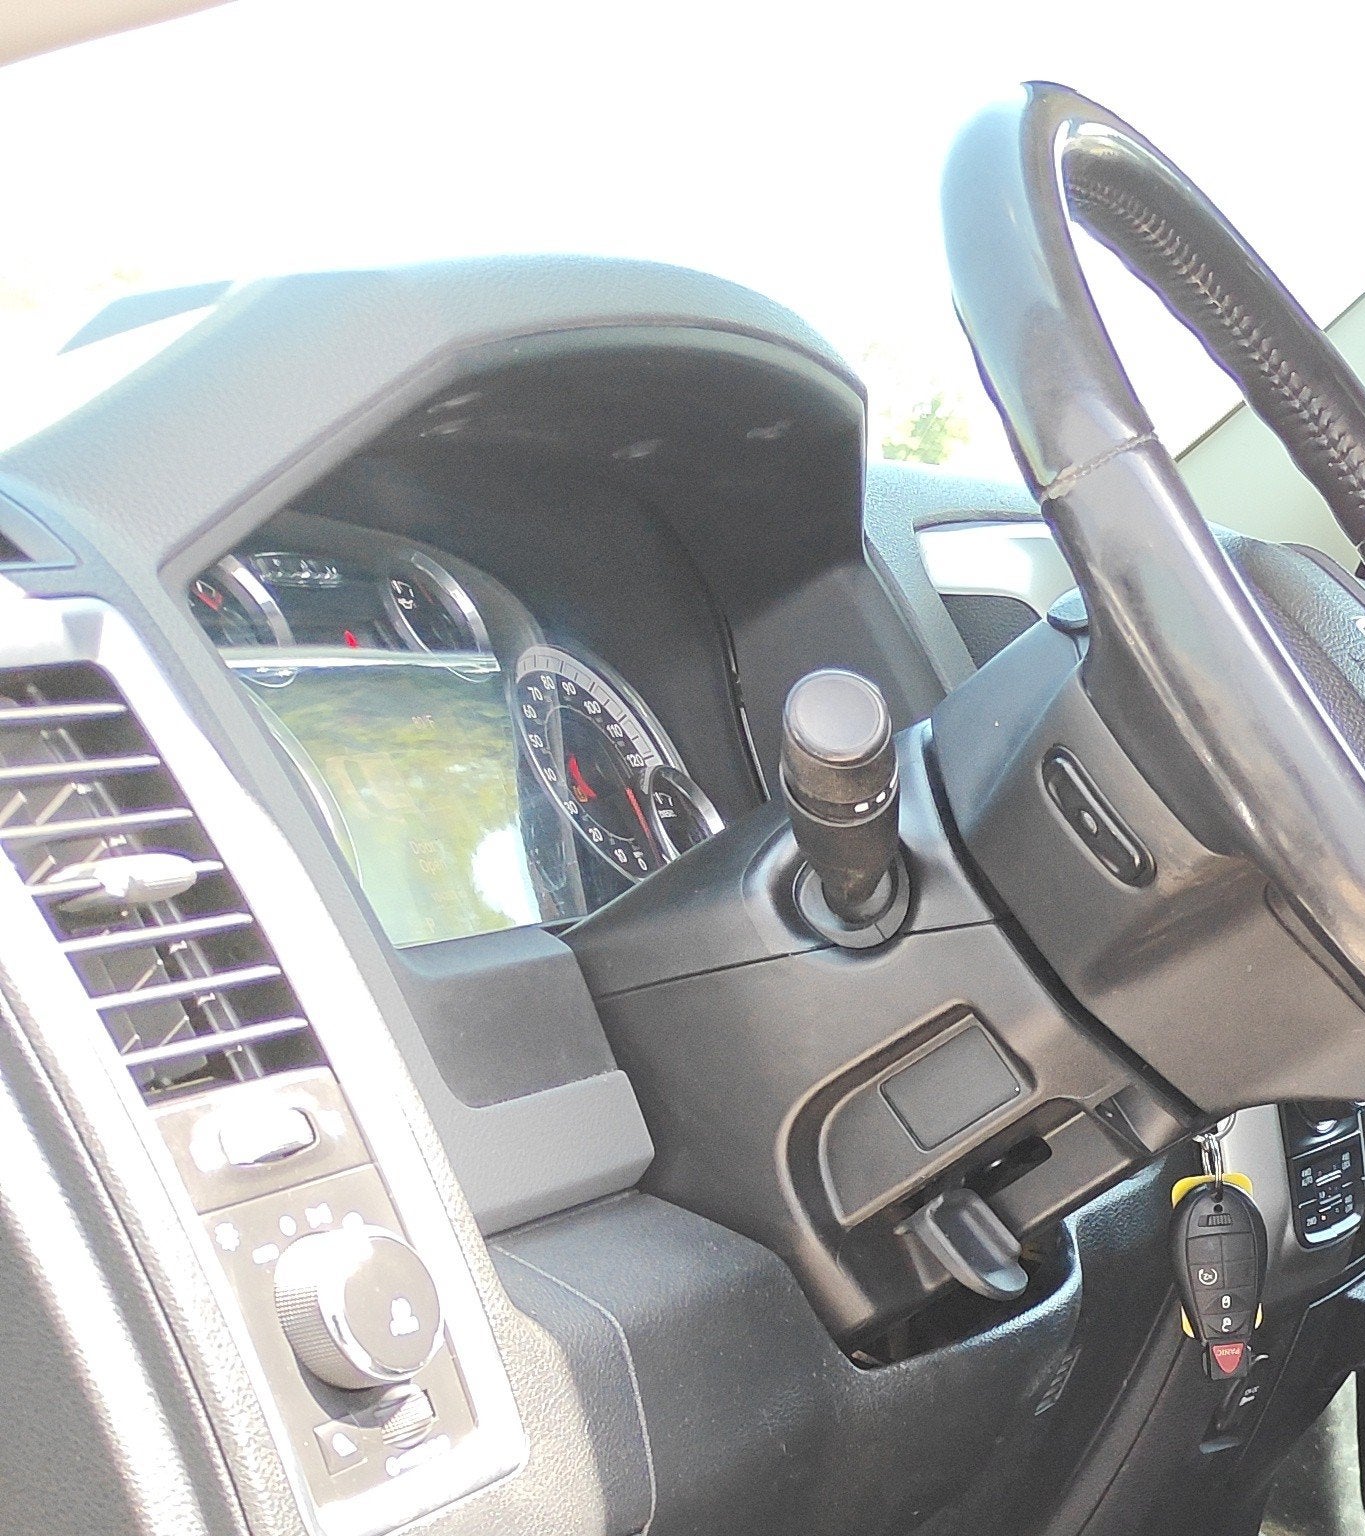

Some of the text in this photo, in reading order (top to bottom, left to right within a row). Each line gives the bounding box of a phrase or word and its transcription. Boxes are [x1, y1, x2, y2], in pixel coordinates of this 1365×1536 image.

[541, 675, 555, 690] 80
[562, 681, 577, 696] 90
[527, 686, 543, 701] 70
[522, 704, 537, 719] 60
[584, 700, 602, 715] 100
[606, 724, 623, 738] 110
[529, 734, 544, 748] 50
[626, 753, 645, 768] 120
[564, 800, 579, 815] 30
[588, 827, 604, 843] 20
